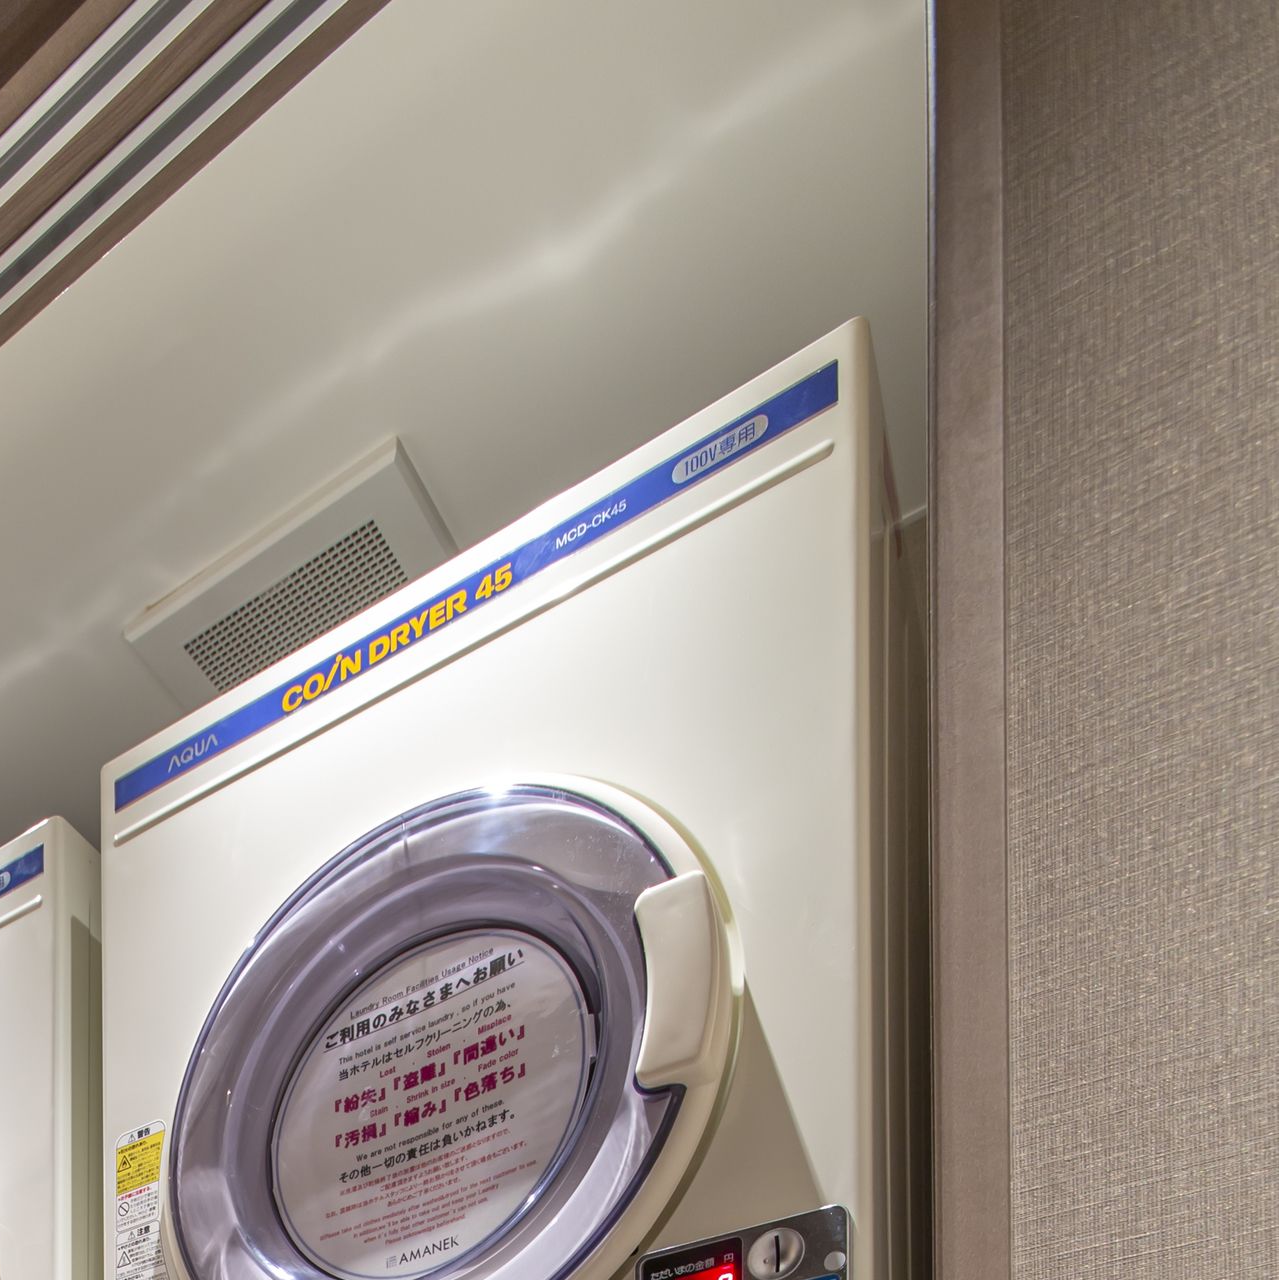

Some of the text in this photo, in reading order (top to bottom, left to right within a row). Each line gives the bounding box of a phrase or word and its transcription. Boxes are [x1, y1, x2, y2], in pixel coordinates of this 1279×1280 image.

[167, 733, 219, 774] AQUA
[367, 591, 469, 671] DRYER
[475, 561, 514, 600] 45
[555, 499, 628, 550] MCD-CK45
[681, 422, 756, 478] 100V専用
[325, 947, 522, 1051] ご利用のみなさまへお願い
[350, 947, 493, 1019] Laundry Room Facilities Usage Notice
[338, 1053, 352, 1065] This
[355, 1045, 372, 1058] hotel
[375, 1042, 380, 1050] is
[384, 1035, 396, 1047] self
[400, 1023, 425, 1040] service
[481, 992, 494, 1005] you
[497, 981, 515, 995] have
[379, 1013, 511, 1078] Lost Stolen Misplace
[369, 1047, 518, 1118] Stain Shrink in size Fade color
[339, 1107, 515, 1185] その他一切の責任は負いかねます。
[356, 1152, 367, 1162] We
[370, 1148, 381, 1157] are
[384, 1142, 395, 1152] not
[398, 1125, 439, 1148] responsible
[442, 1120, 452, 1130] for
[455, 1114, 468, 1125] any
[471, 1108, 478, 1117] of
[399, 1234, 458, 1265] AMANEK
